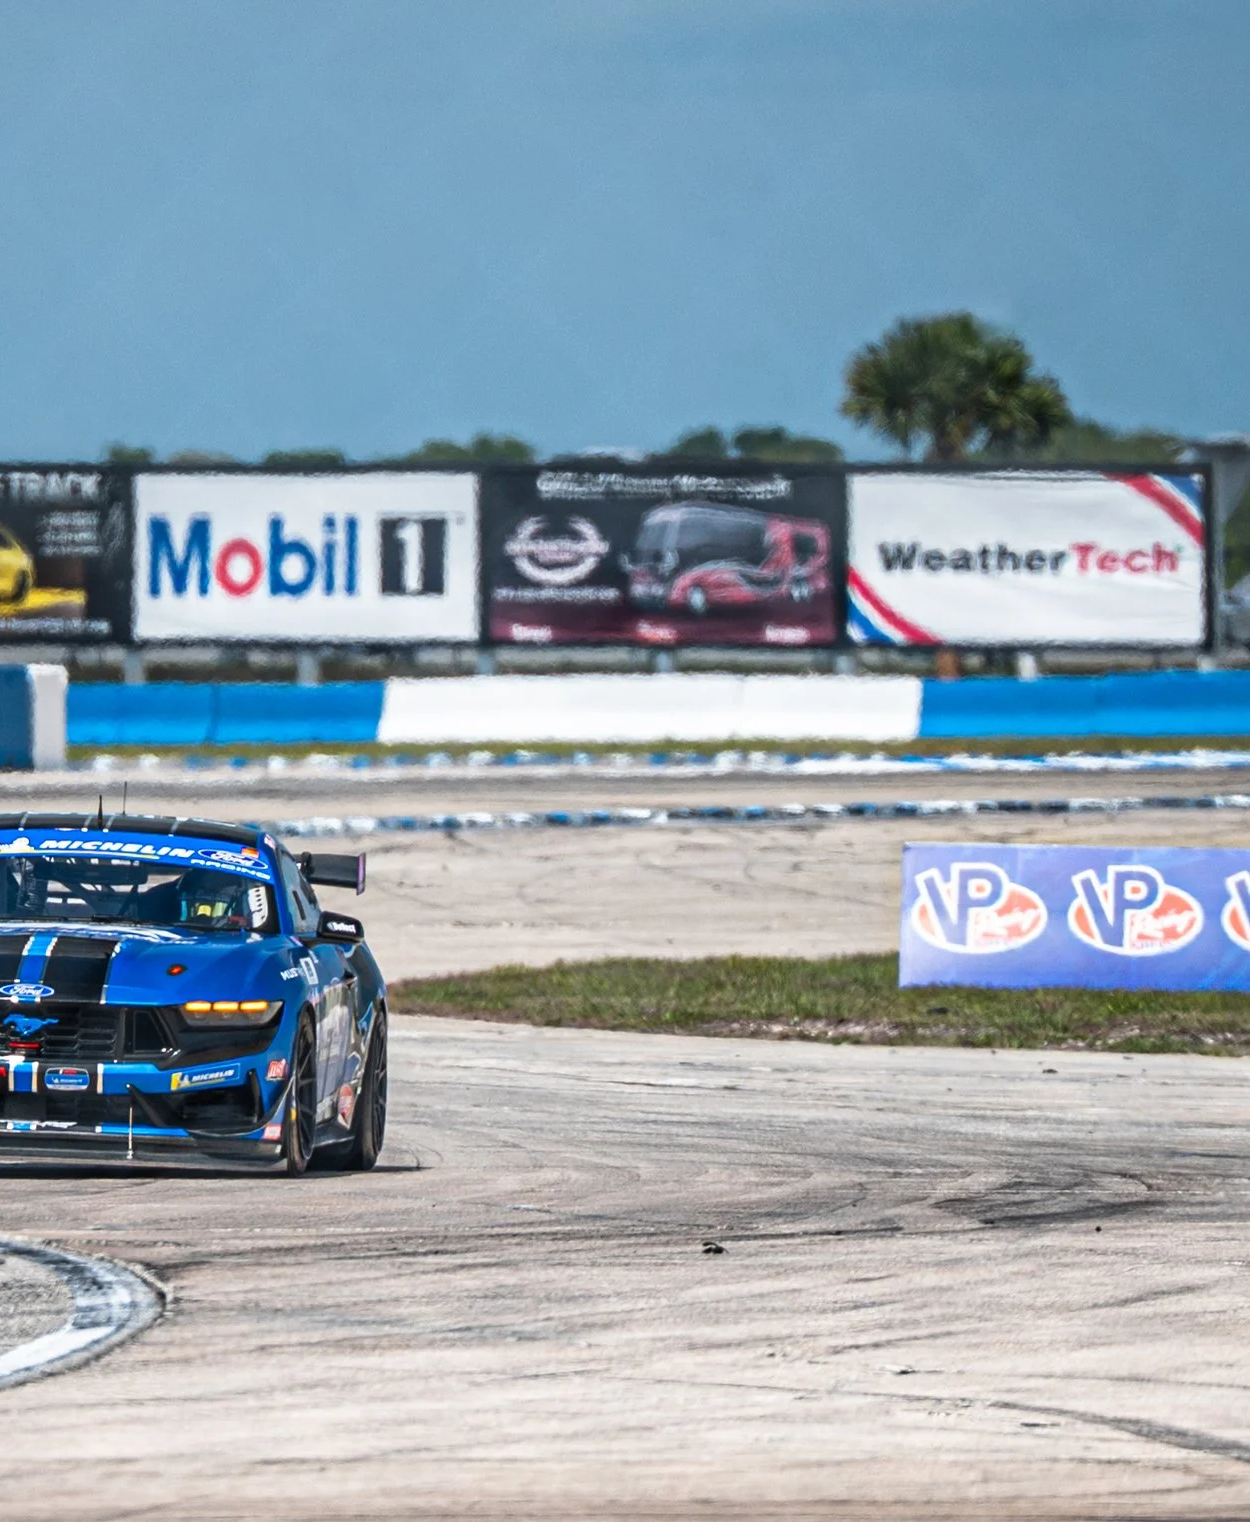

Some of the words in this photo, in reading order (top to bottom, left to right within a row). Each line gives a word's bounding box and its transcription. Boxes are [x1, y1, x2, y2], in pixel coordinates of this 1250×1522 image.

[6, 471, 102, 499] TRACK
[147, 515, 359, 597] Mobil
[395, 518, 430, 595] 1
[877, 541, 1180, 573] WeatherTech
[39, 839, 196, 859] MICHELIN
[209, 850, 256, 869] Ford
[916, 863, 1006, 950] VP
[1073, 866, 1161, 950] VP
[191, 1069, 235, 1083] MICHELIN
